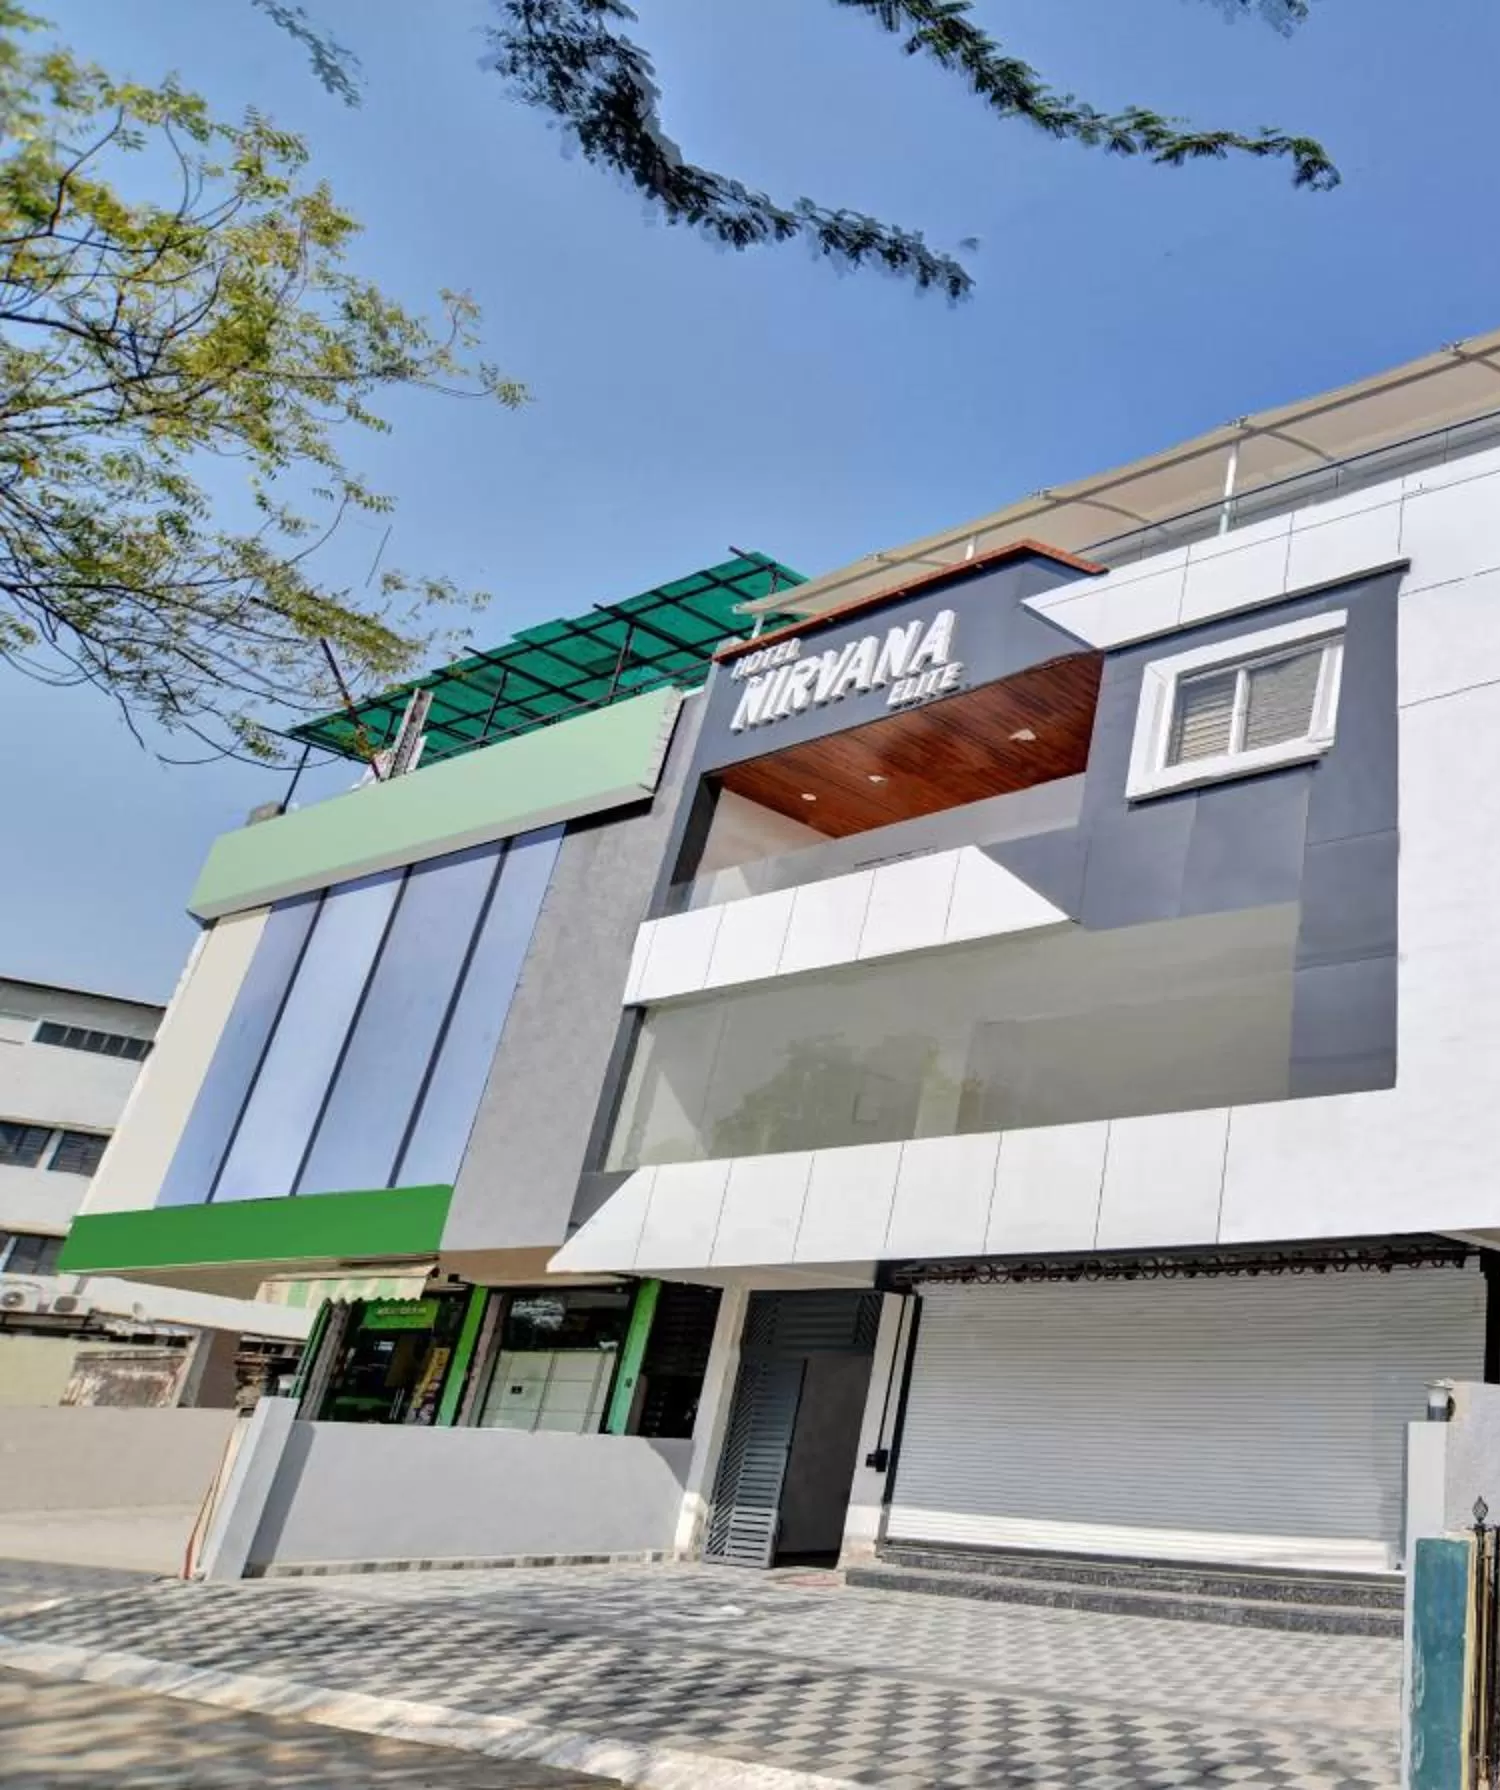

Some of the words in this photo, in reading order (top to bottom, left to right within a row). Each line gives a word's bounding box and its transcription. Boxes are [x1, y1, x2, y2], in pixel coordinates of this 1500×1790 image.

[730, 609, 956, 732] NIRVANA
[731, 637, 800, 679] HOTEL
[886, 661, 964, 706] ELITE
